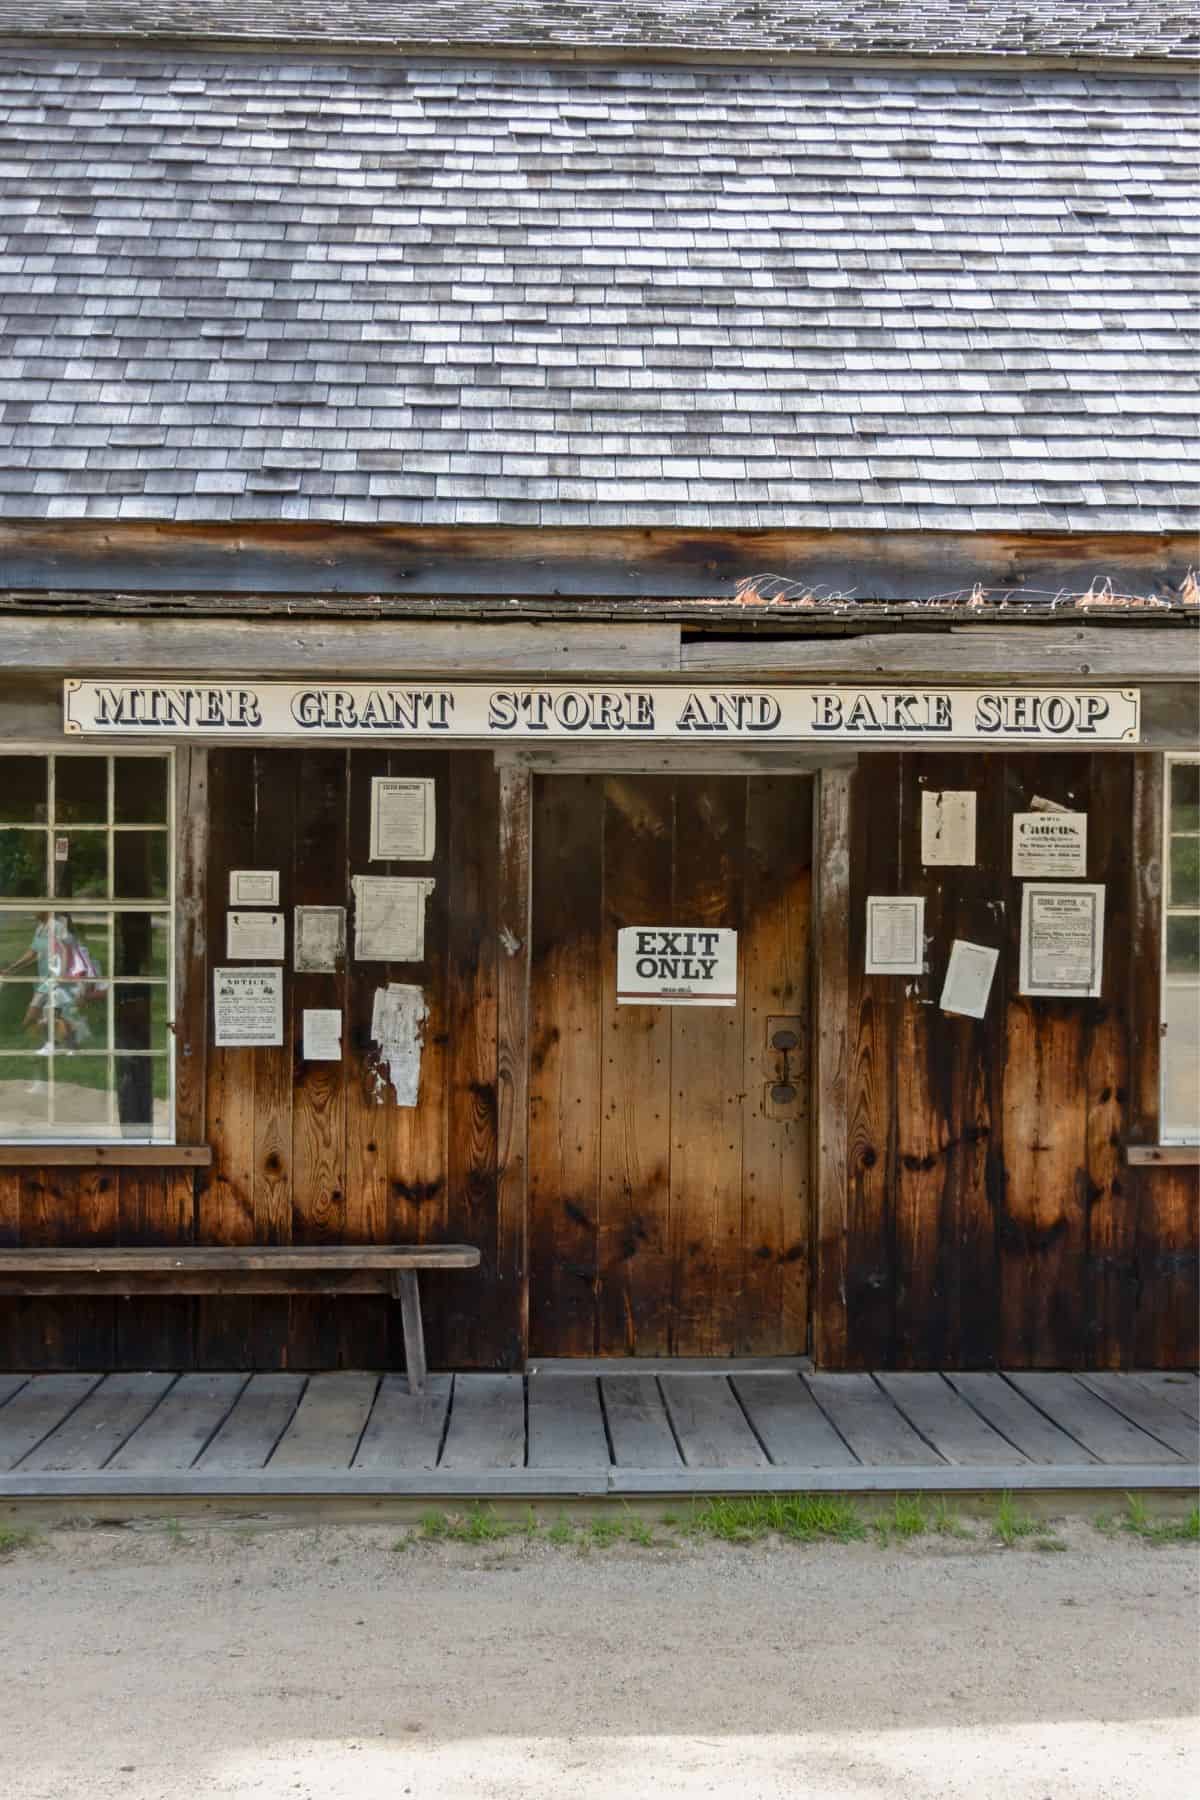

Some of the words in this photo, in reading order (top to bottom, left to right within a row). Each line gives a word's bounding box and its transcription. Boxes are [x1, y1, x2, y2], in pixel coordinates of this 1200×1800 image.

[95, 687, 262, 727] MINER
[290, 689, 455, 730] GRANT
[488, 691, 655, 731] STORE
[676, 692, 782, 732] AND
[810, 693, 953, 733] BAKE
[975, 694, 1110, 734] SHOP
[636, 932, 719, 956] EXIT
[636, 958, 719, 979] ONLY
